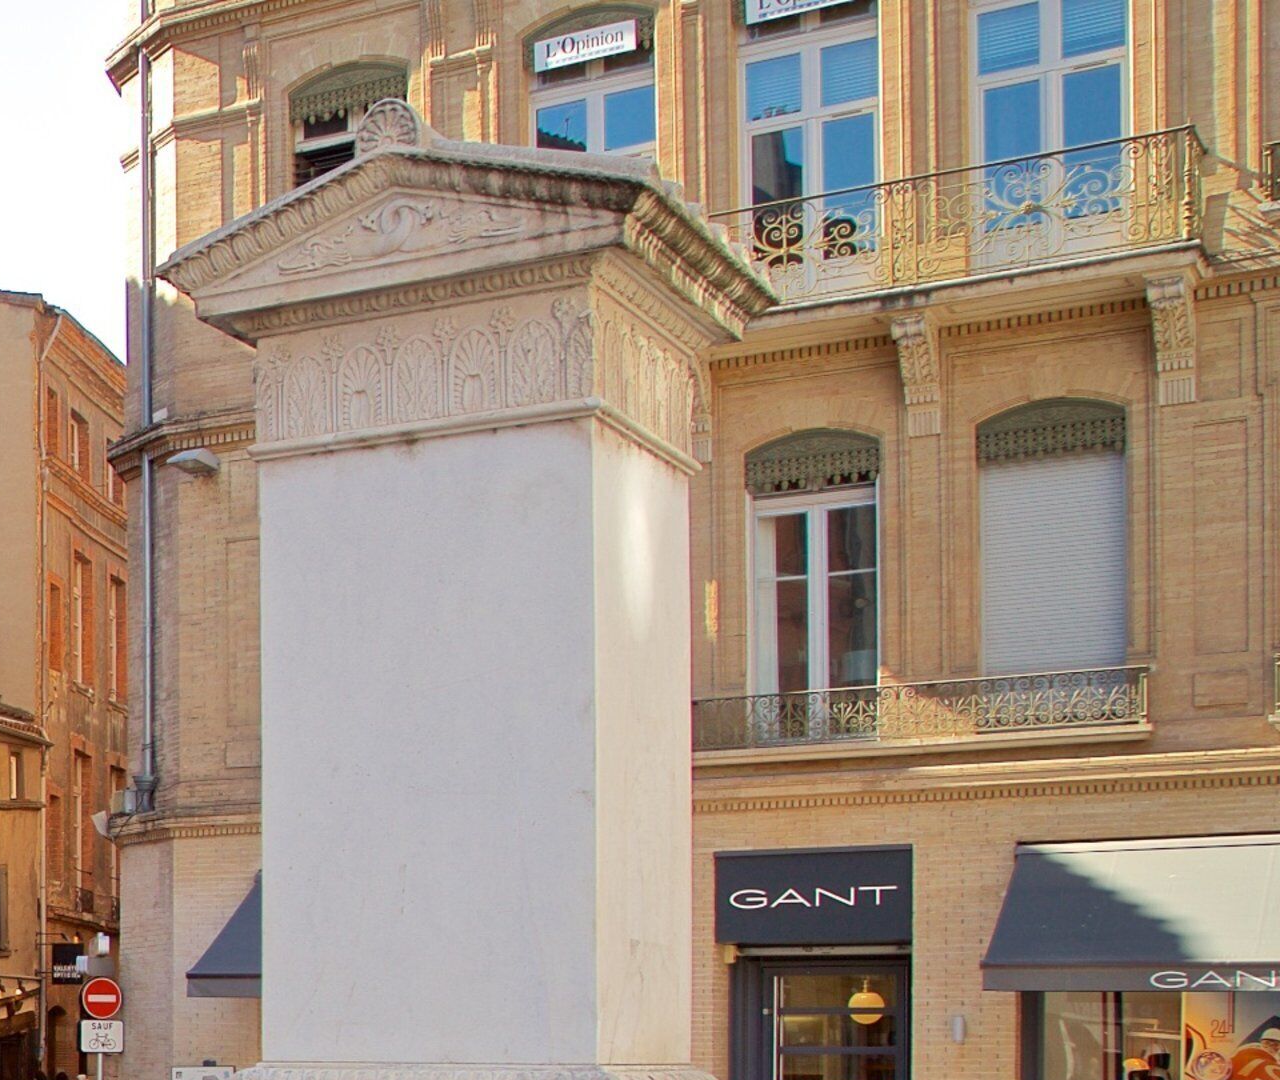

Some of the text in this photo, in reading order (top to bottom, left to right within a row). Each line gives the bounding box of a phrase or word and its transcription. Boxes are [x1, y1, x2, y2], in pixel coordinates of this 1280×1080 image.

[545, 30, 624, 58] L'Opinion
[729, 885, 898, 910] GANT
[1150, 970, 1280, 989] GAN
[91, 1022, 113, 1030] SAUF
